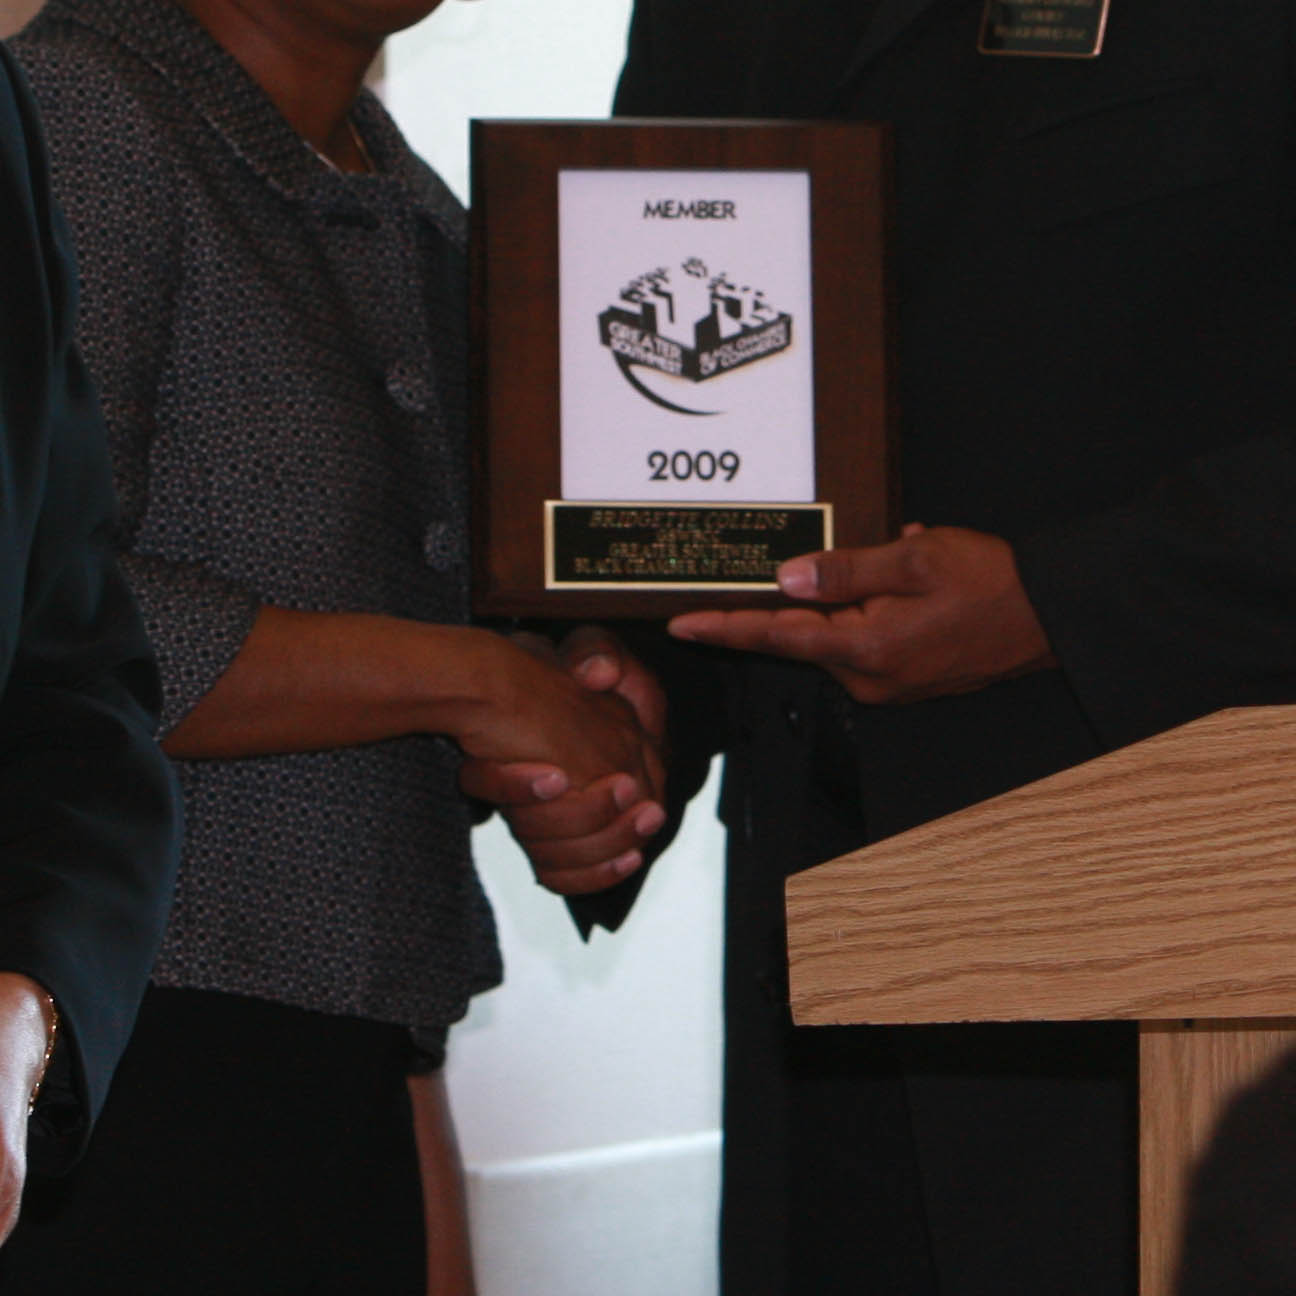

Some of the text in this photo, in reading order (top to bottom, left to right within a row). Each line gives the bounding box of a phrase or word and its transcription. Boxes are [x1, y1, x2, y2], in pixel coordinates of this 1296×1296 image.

[643, 200, 736, 219] MEMBER
[647, 451, 740, 482] 2009
[588, 510, 789, 531] BRIDGETTE COLLINS
